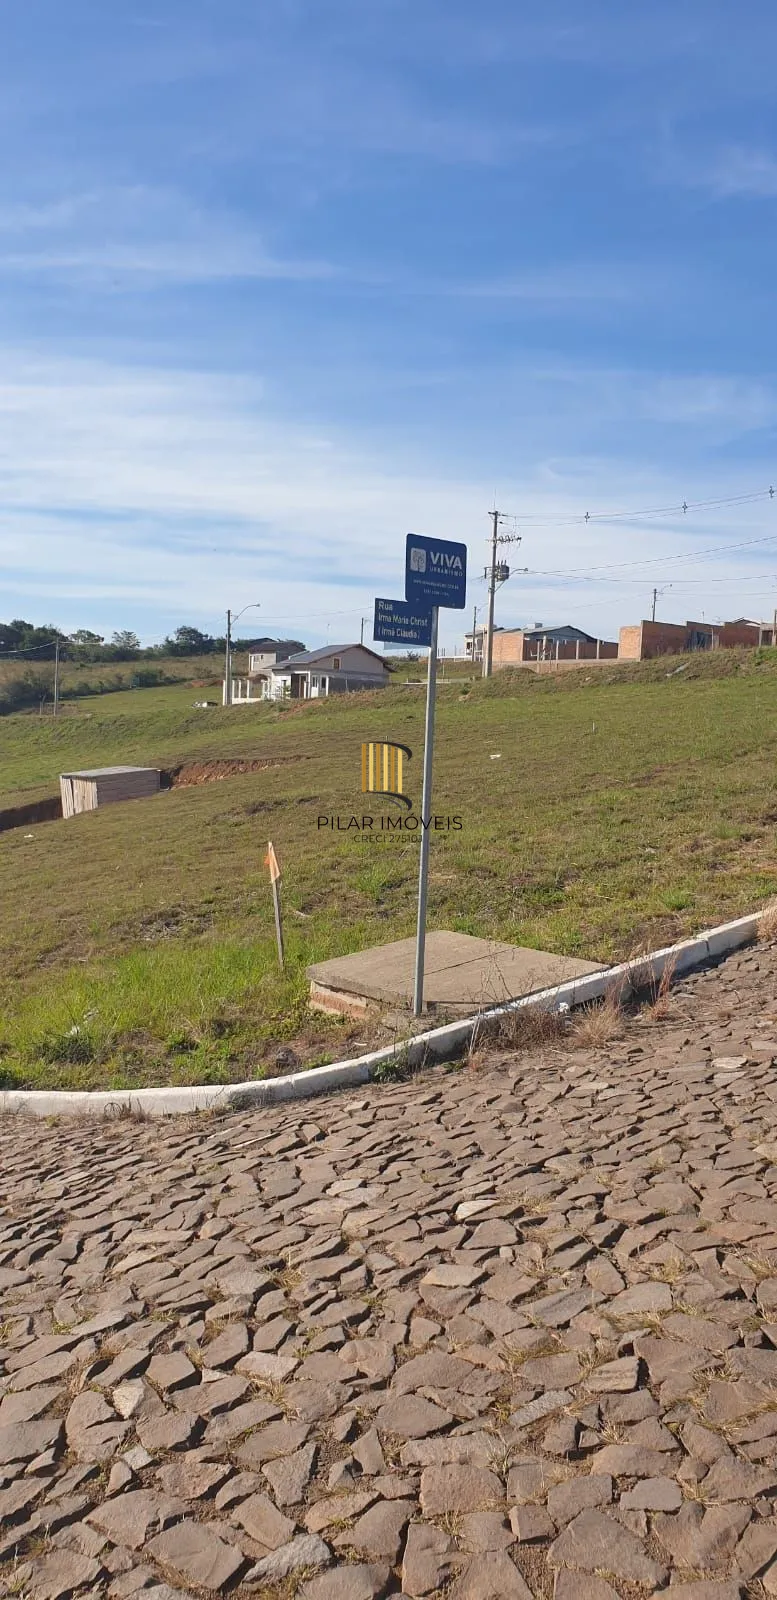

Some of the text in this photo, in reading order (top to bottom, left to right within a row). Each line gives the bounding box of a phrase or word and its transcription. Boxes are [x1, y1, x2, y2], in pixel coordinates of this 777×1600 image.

[430, 551, 462, 570] VIVA
[378, 600, 393, 611] Rua
[392, 614, 409, 625] Maria
